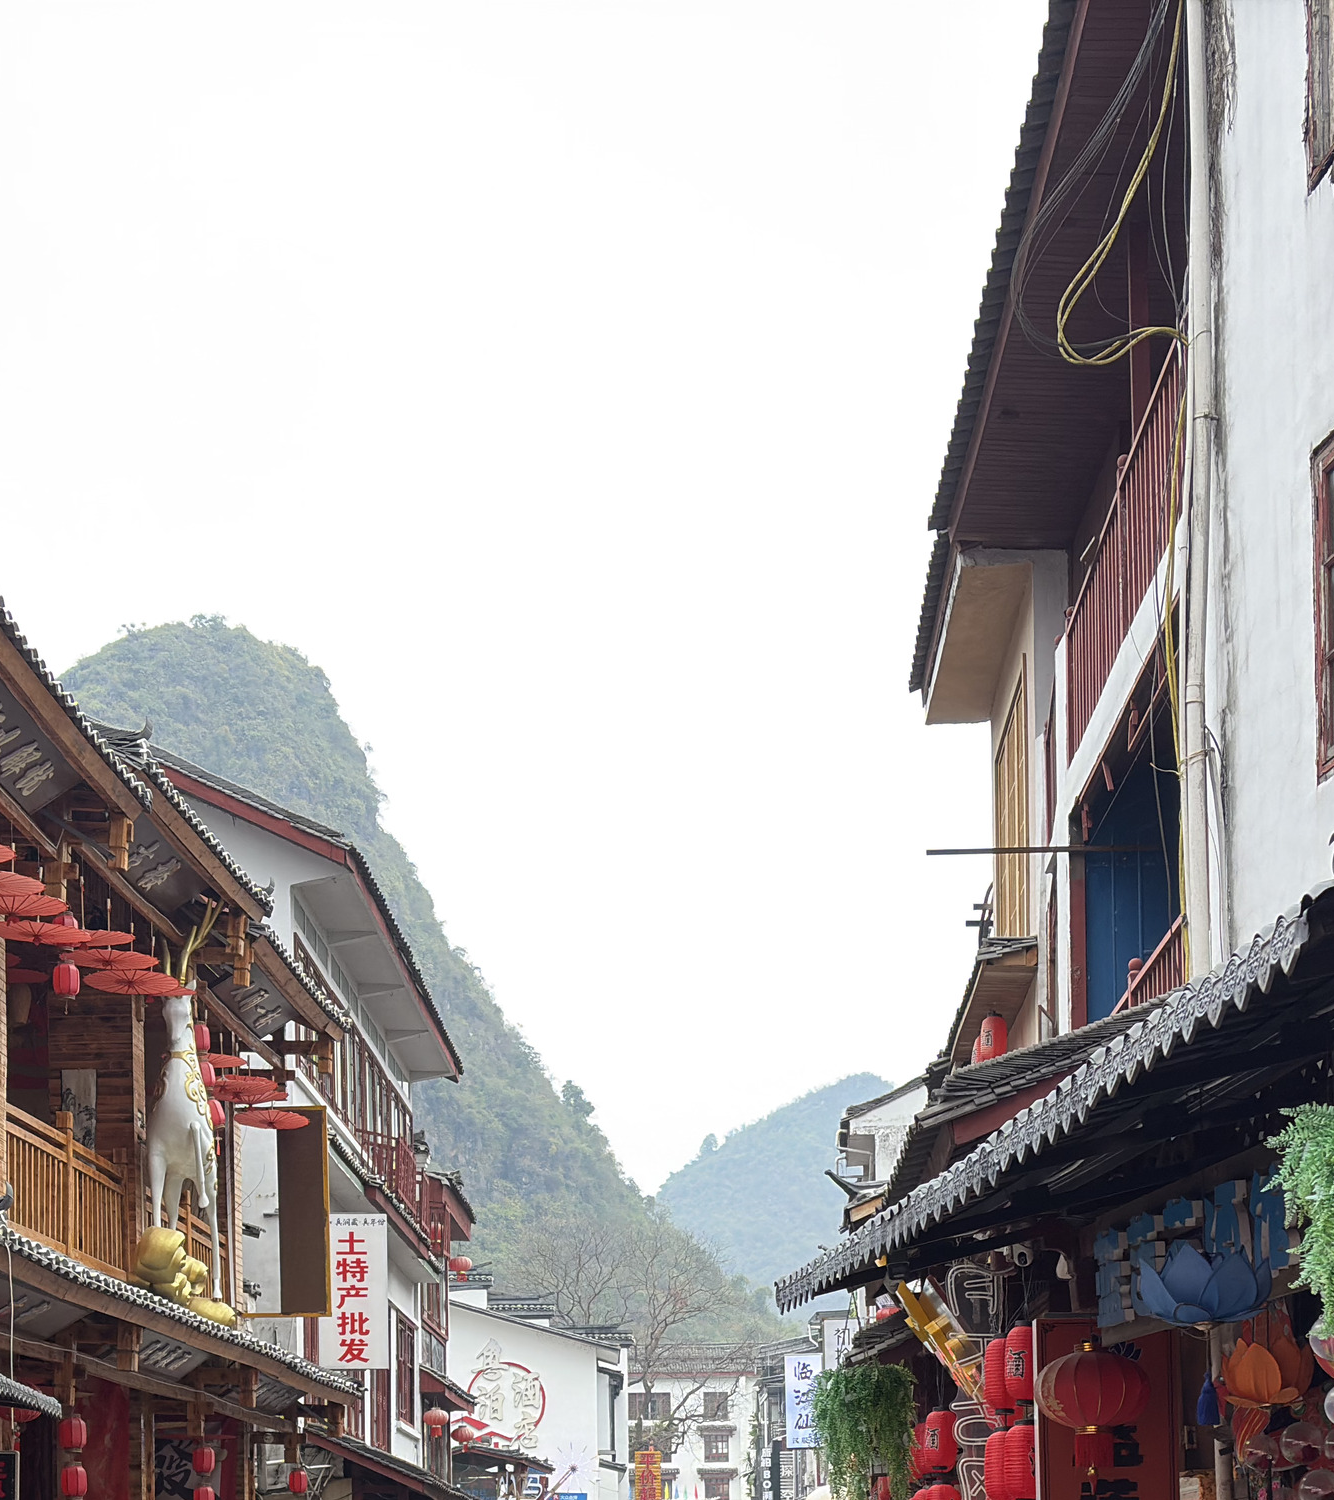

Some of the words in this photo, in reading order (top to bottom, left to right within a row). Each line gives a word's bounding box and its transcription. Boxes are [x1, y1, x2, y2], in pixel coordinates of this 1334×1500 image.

[335, 1231, 370, 1364] 土特产批发
